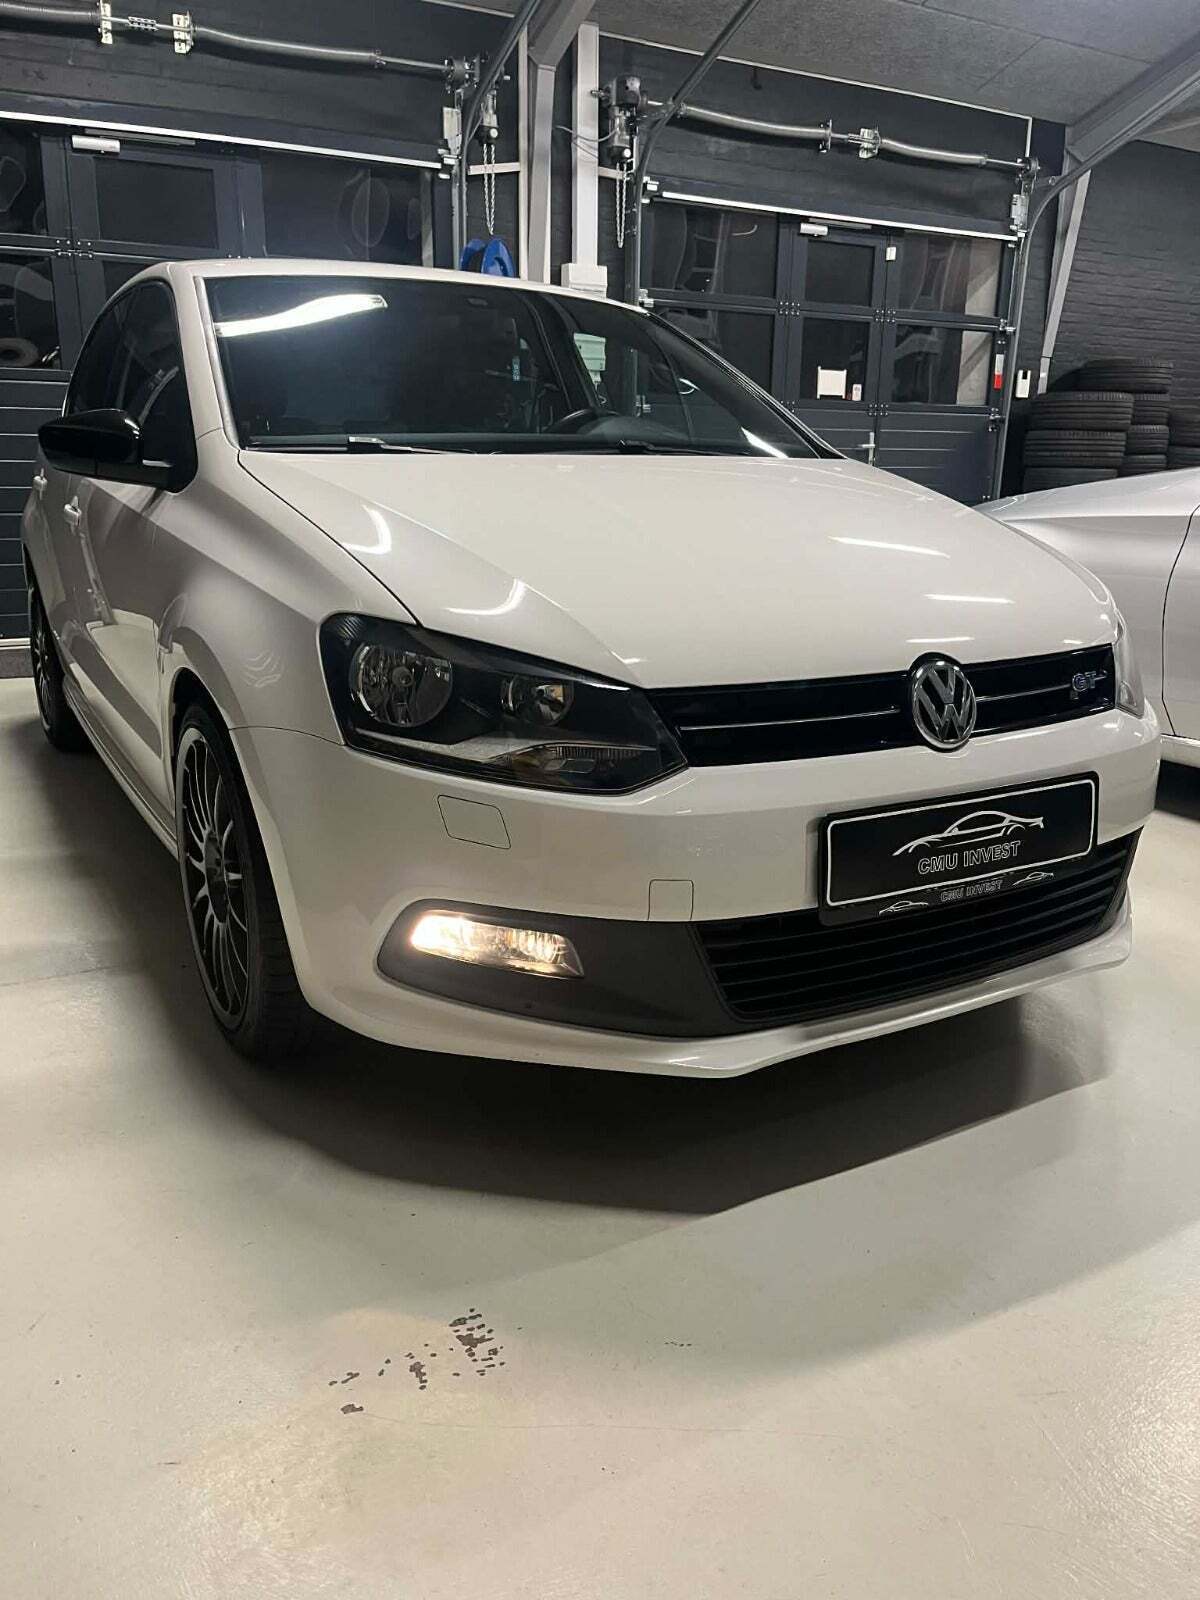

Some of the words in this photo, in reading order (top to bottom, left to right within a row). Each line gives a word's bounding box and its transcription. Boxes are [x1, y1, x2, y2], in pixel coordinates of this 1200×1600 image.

[914, 662, 975, 743] VW
[917, 853, 958, 875] CMU
[963, 840, 1021, 867] INVEST
[940, 886, 964, 902] CMU
[966, 880, 1003, 896] INVEST
